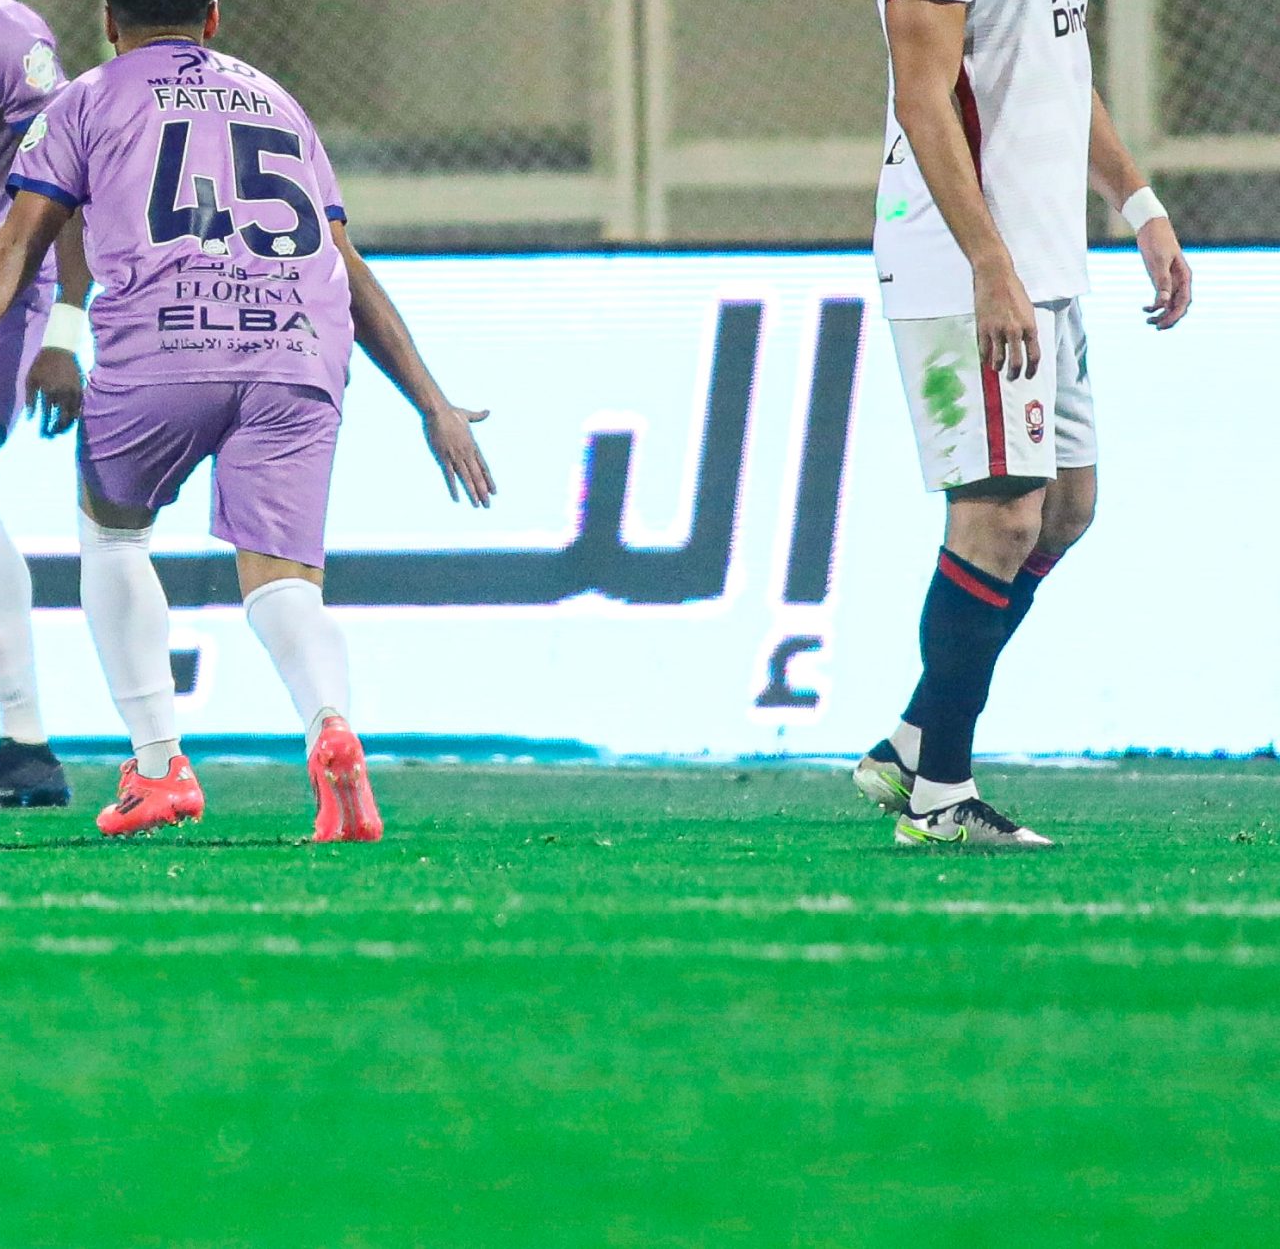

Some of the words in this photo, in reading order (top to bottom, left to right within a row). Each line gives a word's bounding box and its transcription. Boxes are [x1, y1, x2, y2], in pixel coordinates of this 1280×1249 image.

[153, 86, 273, 116] FATTAH
[146, 119, 323, 259] 45
[175, 280, 304, 305] FLORINA
[157, 304, 320, 340] ELBA
